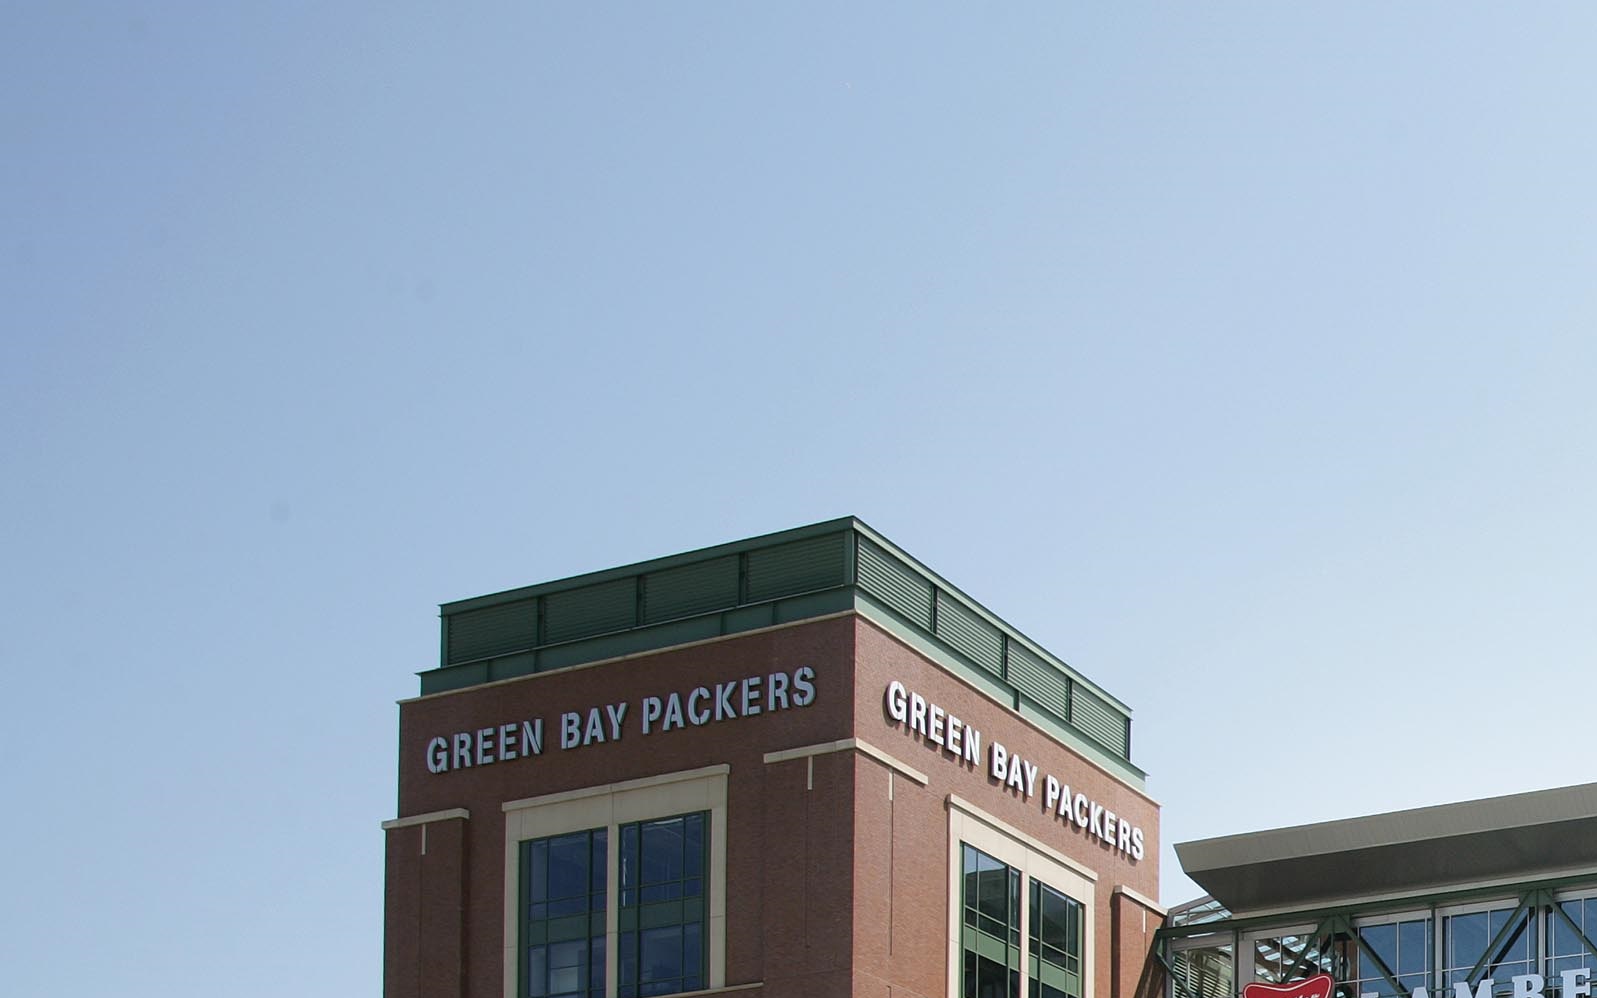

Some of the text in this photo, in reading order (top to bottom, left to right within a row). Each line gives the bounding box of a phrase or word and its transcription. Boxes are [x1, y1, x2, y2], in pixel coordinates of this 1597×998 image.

[427, 666, 816, 774] GREEN BAY PACKERS
[886, 680, 1144, 861] GREEN BAY PACKERS
